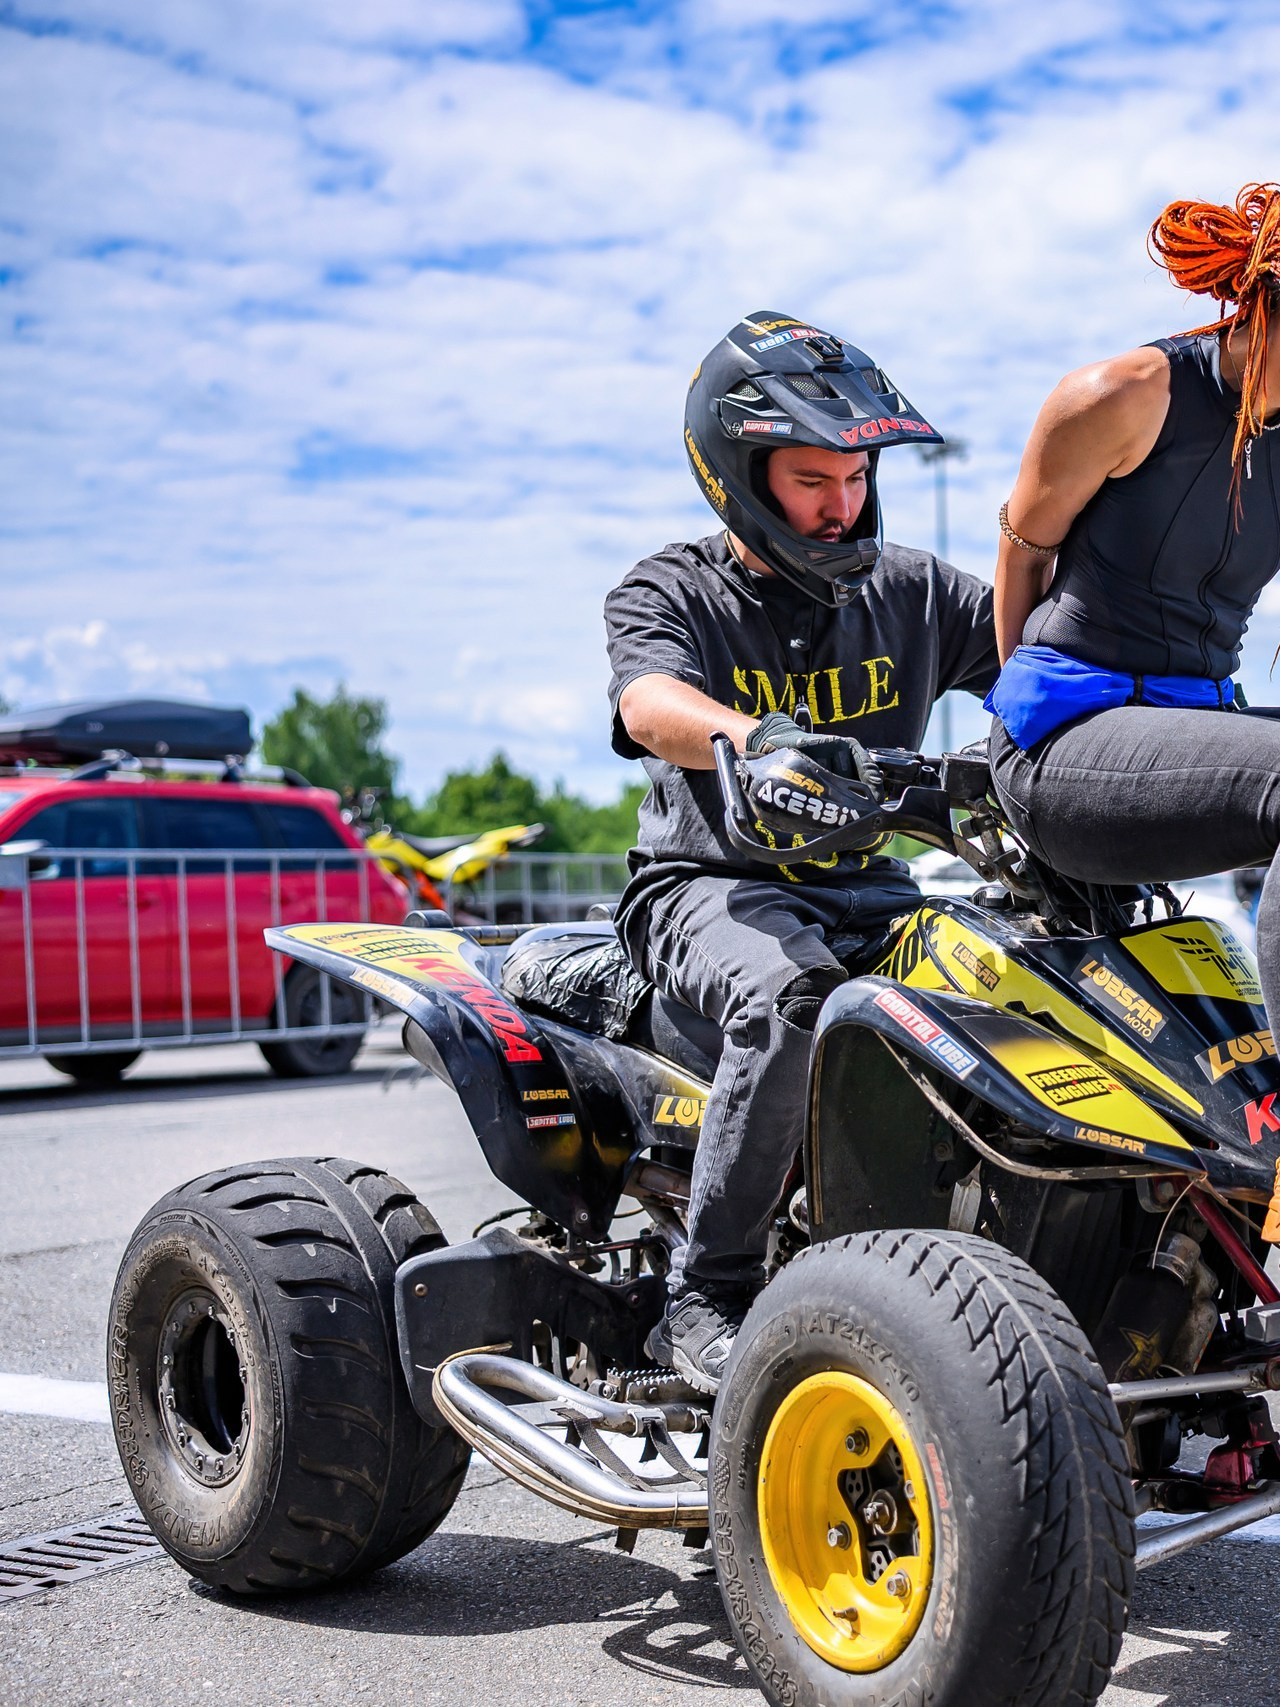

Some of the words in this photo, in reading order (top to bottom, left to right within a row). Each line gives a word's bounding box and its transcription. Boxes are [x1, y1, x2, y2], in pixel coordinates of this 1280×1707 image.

[745, 421, 772, 431] CAPITAL
[839, 417, 934, 446] KENDA
[685, 427, 727, 507] LUBSAR
[705, 485, 725, 511] MOTO
[954, 944, 998, 989] LUBSAR
[401, 957, 543, 1062] KENDA
[1081, 960, 1163, 1030] LUBSAR
[882, 990, 937, 1041] CAPITAL
[930, 1037, 974, 1070] LUBE
[1123, 1013, 1152, 1037] MOTO
[523, 1089, 570, 1101] LUBSAR
[1076, 1127, 1145, 1154] LUBSAR
